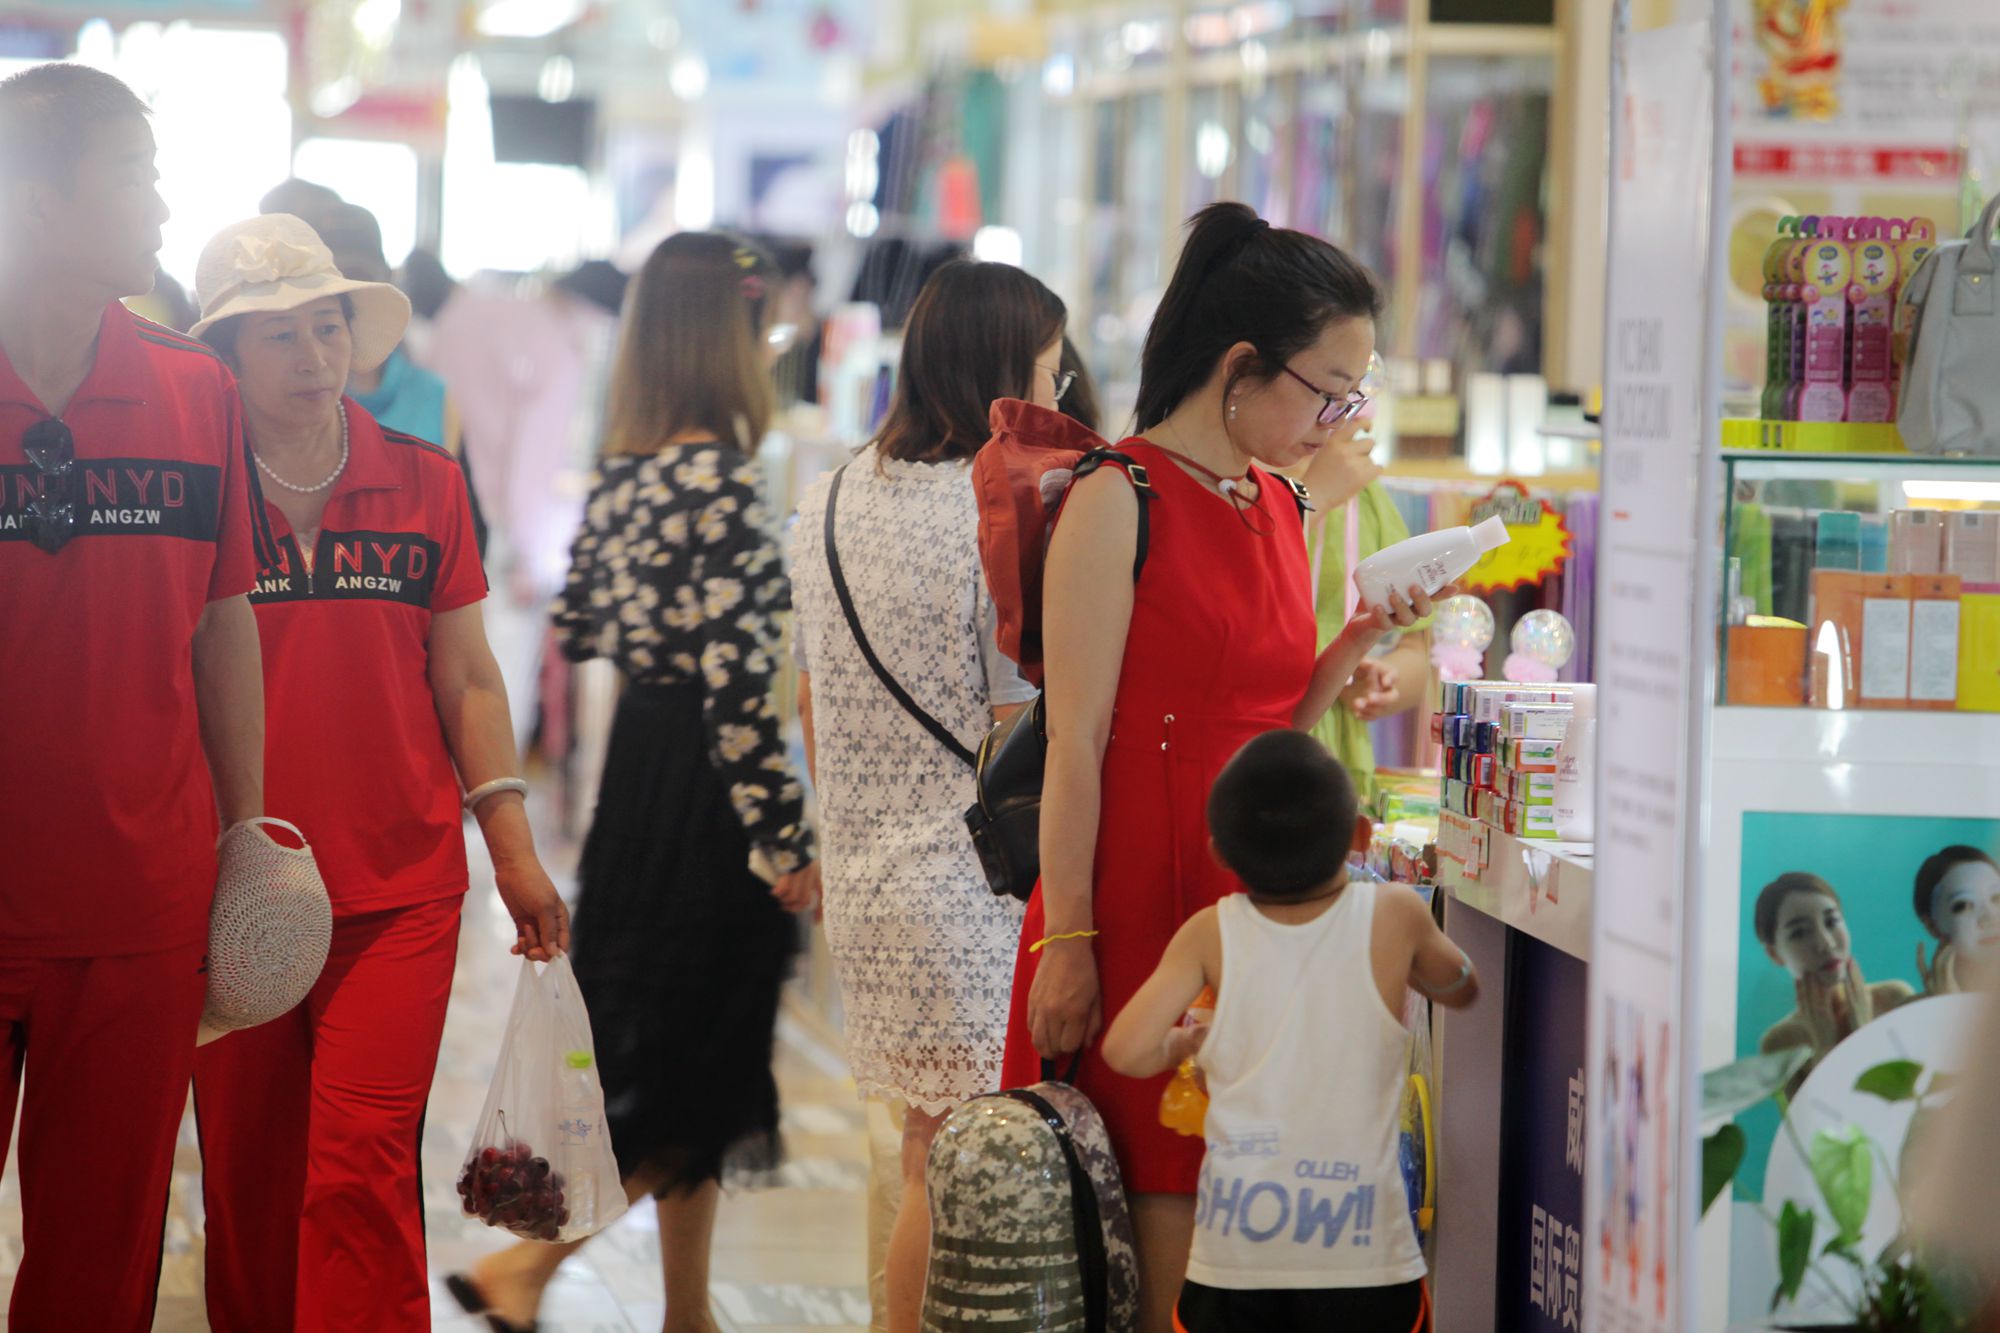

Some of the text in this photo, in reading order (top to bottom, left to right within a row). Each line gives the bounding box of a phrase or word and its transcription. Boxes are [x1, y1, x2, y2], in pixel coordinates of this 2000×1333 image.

[85, 467, 185, 508] NYD
[89, 509, 161, 525] ANGZW
[333, 540, 428, 580] NYD
[334, 575, 402, 593] ANGZW
[1294, 1159, 1360, 1182] OLLEH
